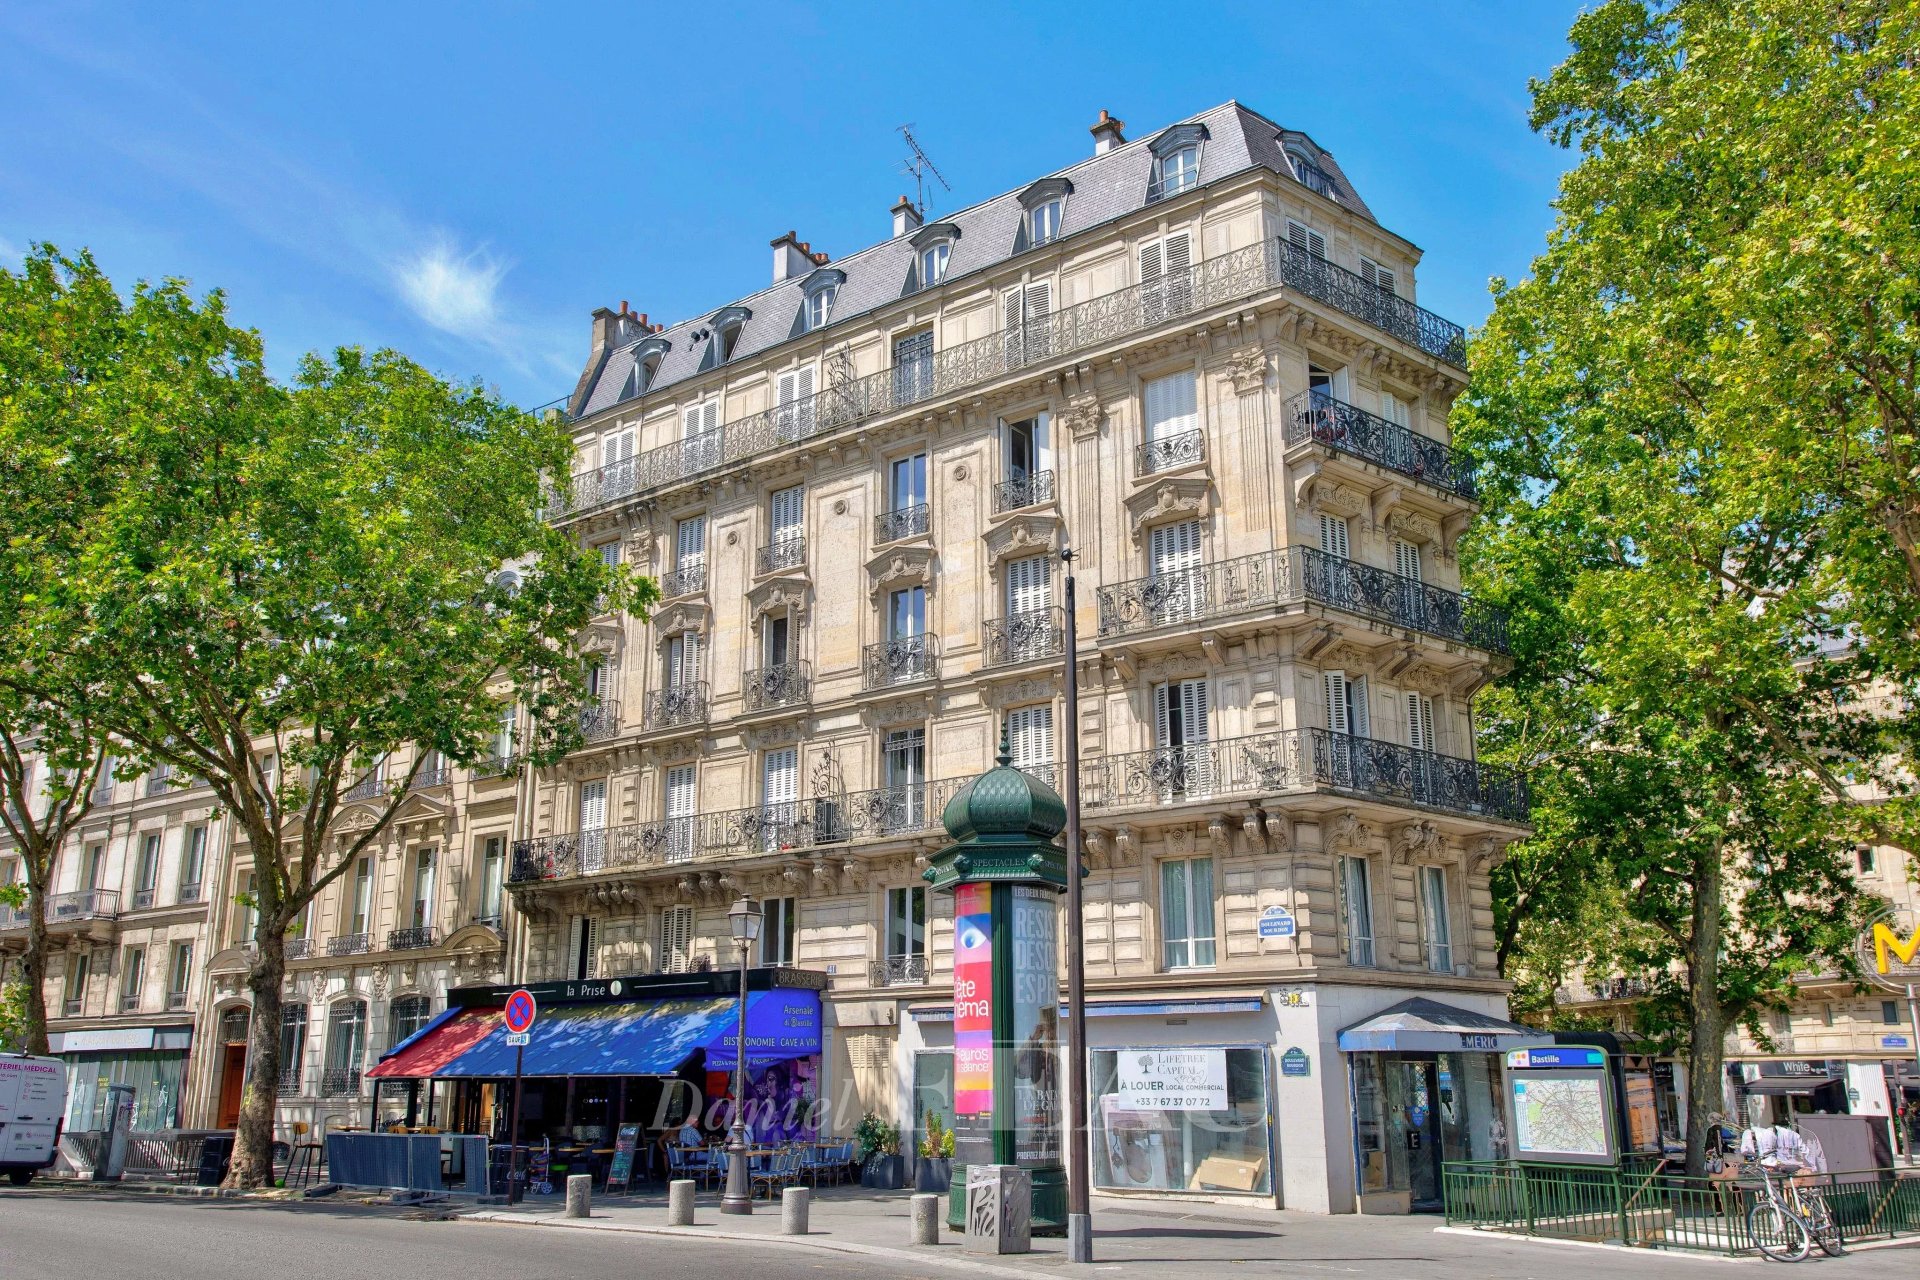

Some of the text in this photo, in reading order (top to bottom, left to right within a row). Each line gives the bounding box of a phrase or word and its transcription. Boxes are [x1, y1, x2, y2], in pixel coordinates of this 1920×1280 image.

[972, 858, 1025, 867] SPECTACLES
[566, 984, 605, 996] la Prise
[784, 1005, 814, 1015] Arsenale
[723, 1036, 775, 1047] BISTONOMIE
[780, 1038, 798, 1047] CAVE
[805, 1037, 817, 1046] VIN
[1531, 1055, 1560, 1063] Bastille
[24, 1063, 57, 1074] MÉDICAL
[1783, 1061, 1810, 1072] White
[1131, 1081, 1164, 1090] LOUER
[1136, 1097, 1210, 1106] +33 7 67 37 07 72
